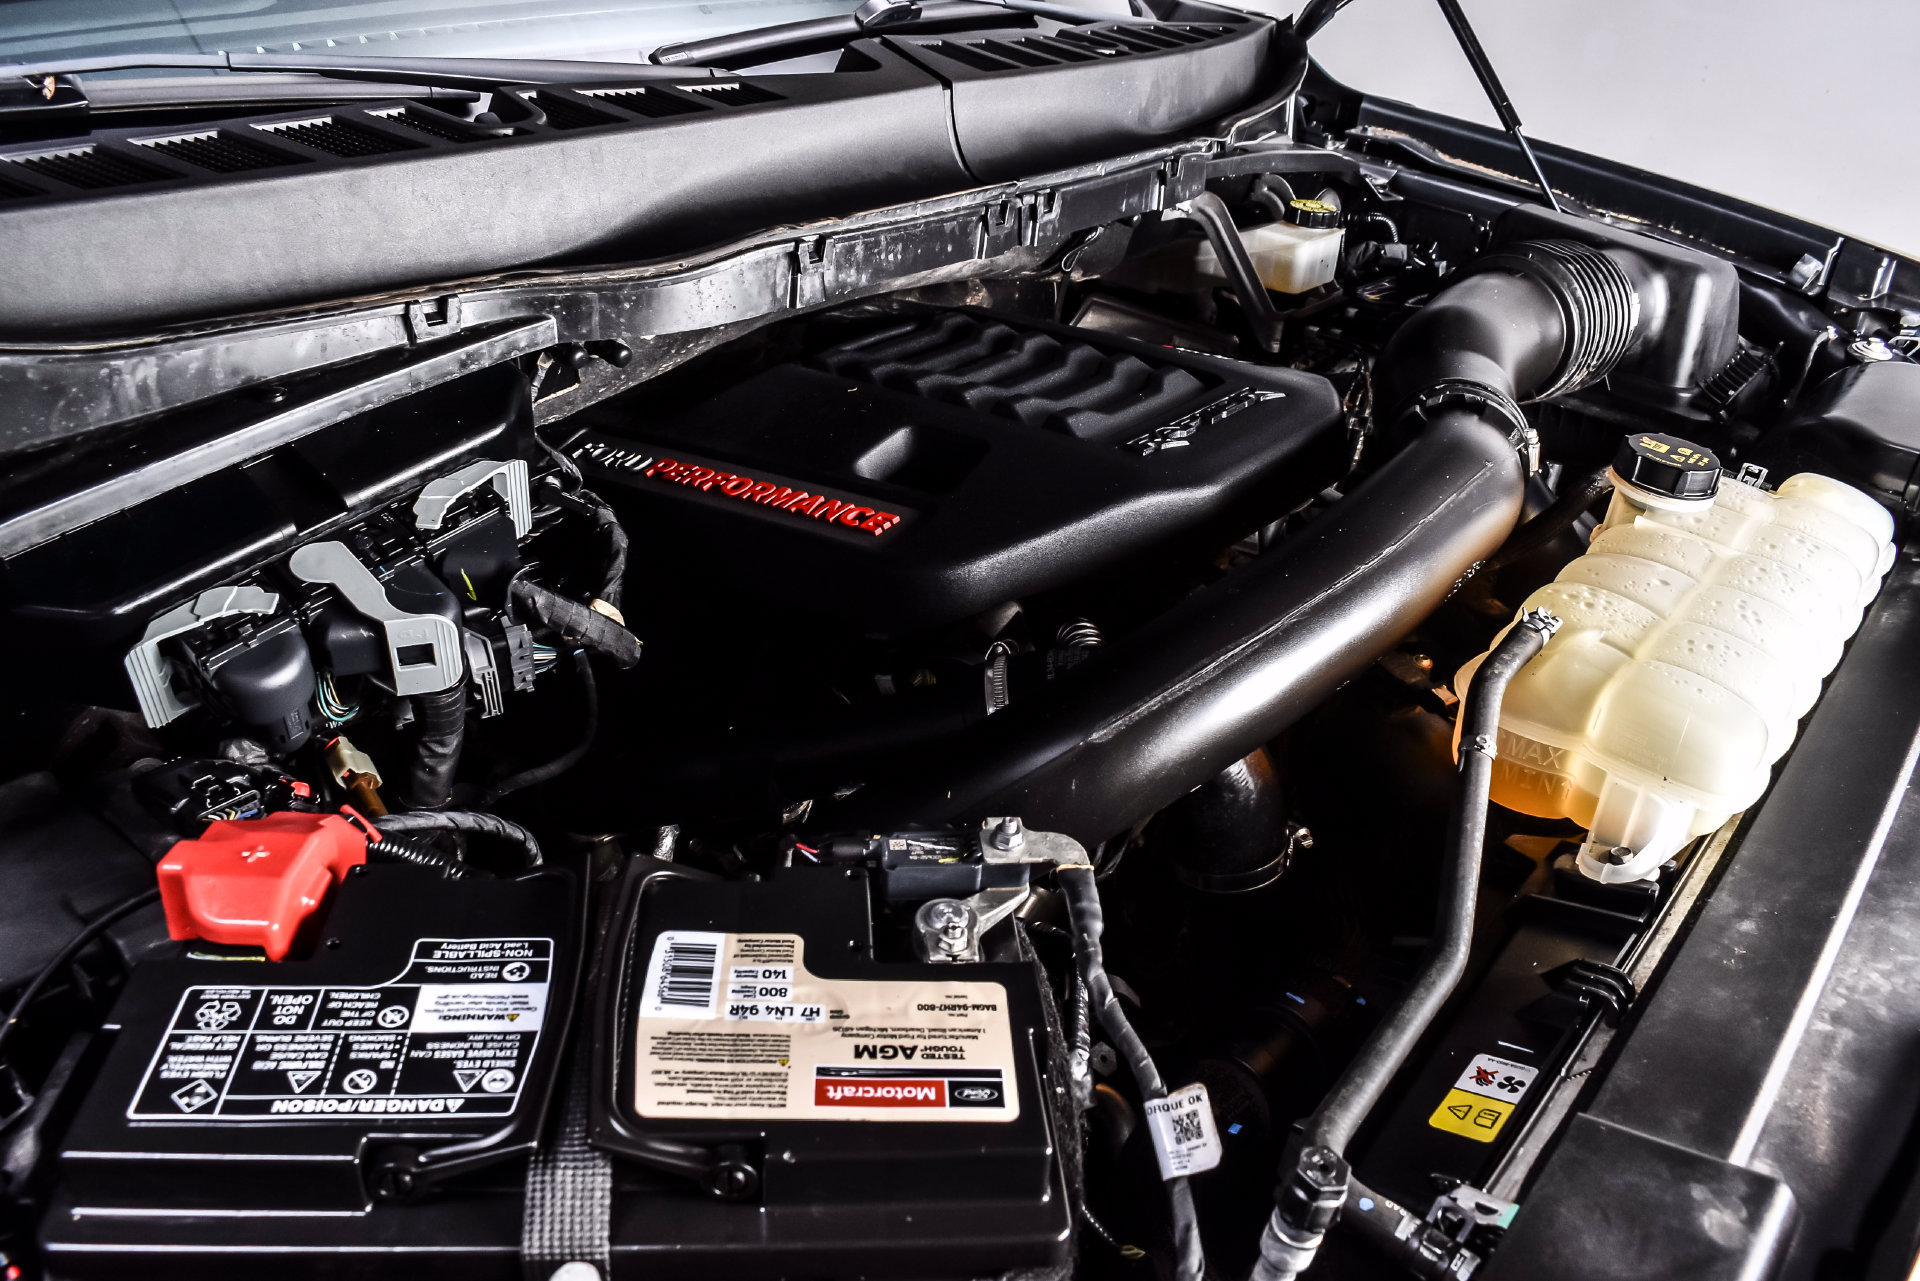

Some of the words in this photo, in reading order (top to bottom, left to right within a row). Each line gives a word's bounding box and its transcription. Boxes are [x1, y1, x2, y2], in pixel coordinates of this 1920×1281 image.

[644, 458, 900, 536] PERFORMANCE
[1507, 737, 1568, 769] MAX
[1501, 764, 1554, 796] MIN
[441, 942, 478, 951] Battery
[503, 942, 529, 950] Lead
[432, 949, 533, 959] NON-SPILLABLE
[425, 965, 500, 973] INSTRUCTIONS.
[762, 969, 787, 980] 140
[759, 987, 788, 998] 800
[269, 994, 314, 1005] OPEN.
[272, 1005, 305, 1015] NOT
[326, 1001, 343, 1009] OF
[342, 1001, 379, 1009] REACH
[339, 1010, 360, 1018] THE
[361, 1010, 376, 1018] OF
[729, 1005, 760, 1016] 94R
[765, 1005, 794, 1017] LN4
[800, 1007, 820, 1017] H7
[273, 1015, 297, 1025] DO
[438, 1013, 506, 1021] WARNING:
[344, 1019, 374, 1027] KEEP
[352, 1042, 394, 1051] FLAMES
[425, 1042, 484, 1050] BLINDNESS
[486, 1041, 520, 1049] CAUSE
[409, 1050, 433, 1058] CAN
[433, 1050, 465, 1058] GASES
[466, 1049, 518, 1058] EXPLOSIVE
[853, 1045, 919, 1060] AGM
[825, 1085, 936, 1101] Motorcraft
[270, 1099, 446, 1113] DANGER/POISON
[1146, 1099, 1185, 1116] ORQUE
[1188, 1094, 1204, 1105] OK
